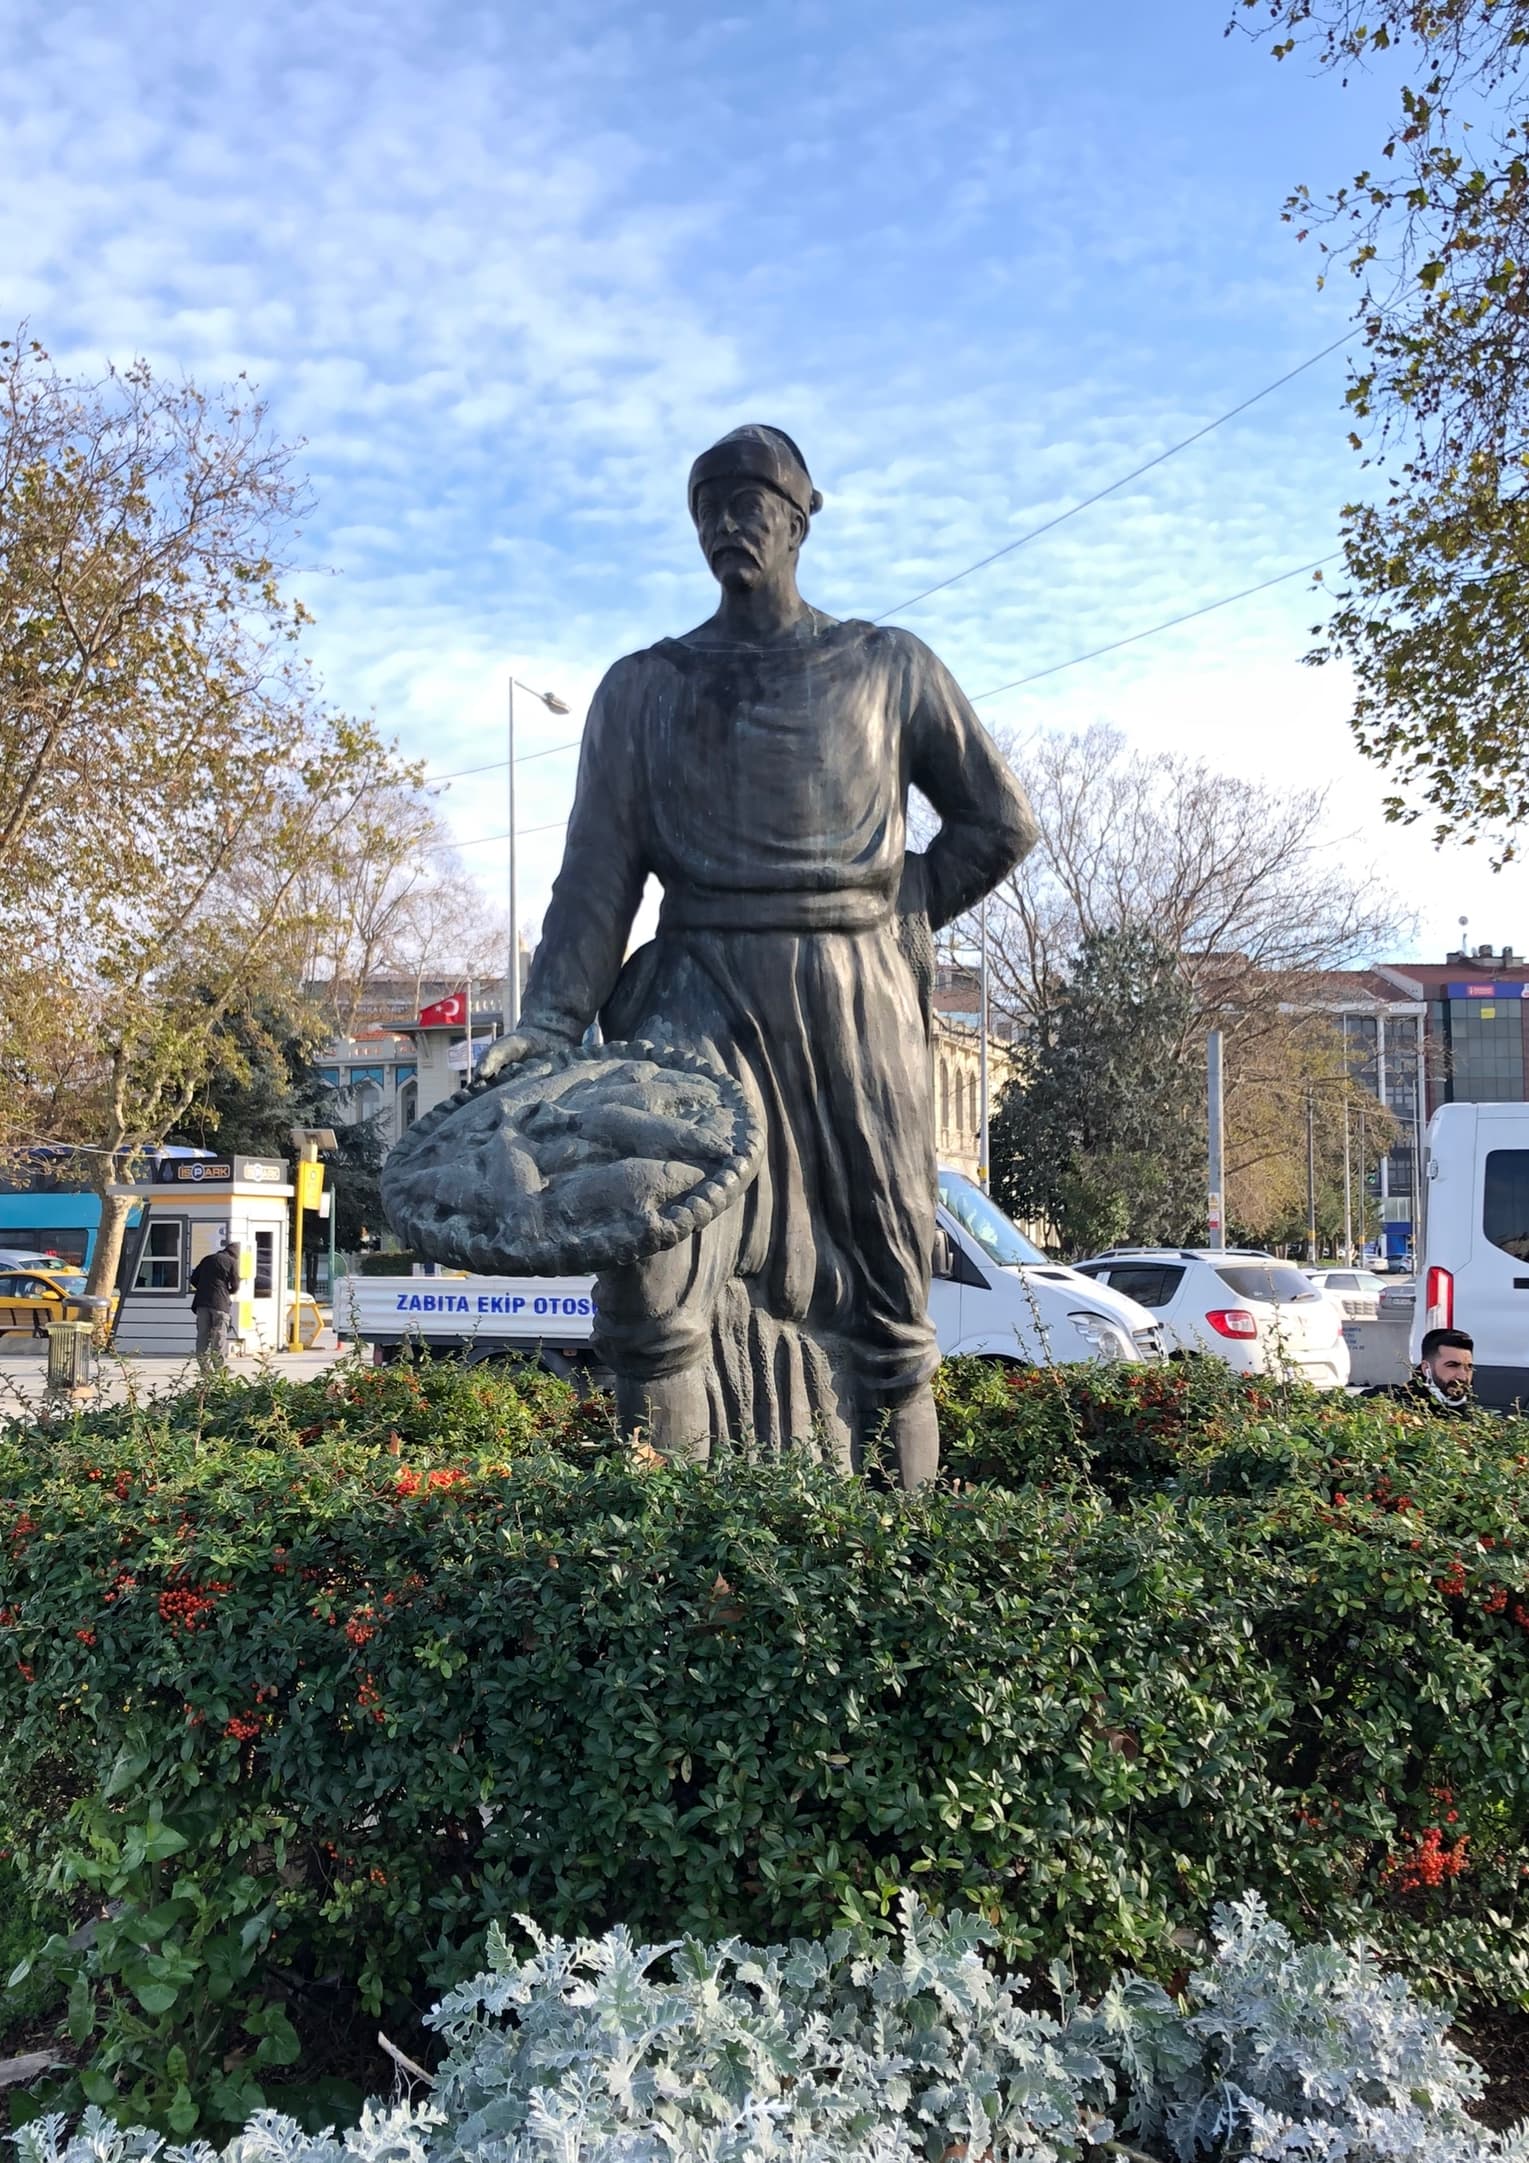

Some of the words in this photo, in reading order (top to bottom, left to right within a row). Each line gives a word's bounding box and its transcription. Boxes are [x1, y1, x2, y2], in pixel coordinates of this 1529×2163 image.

[179, 1163, 229, 1181] İSPARK
[397, 1294, 470, 1312] ZABITA
[477, 1292, 526, 1314] EKİP
